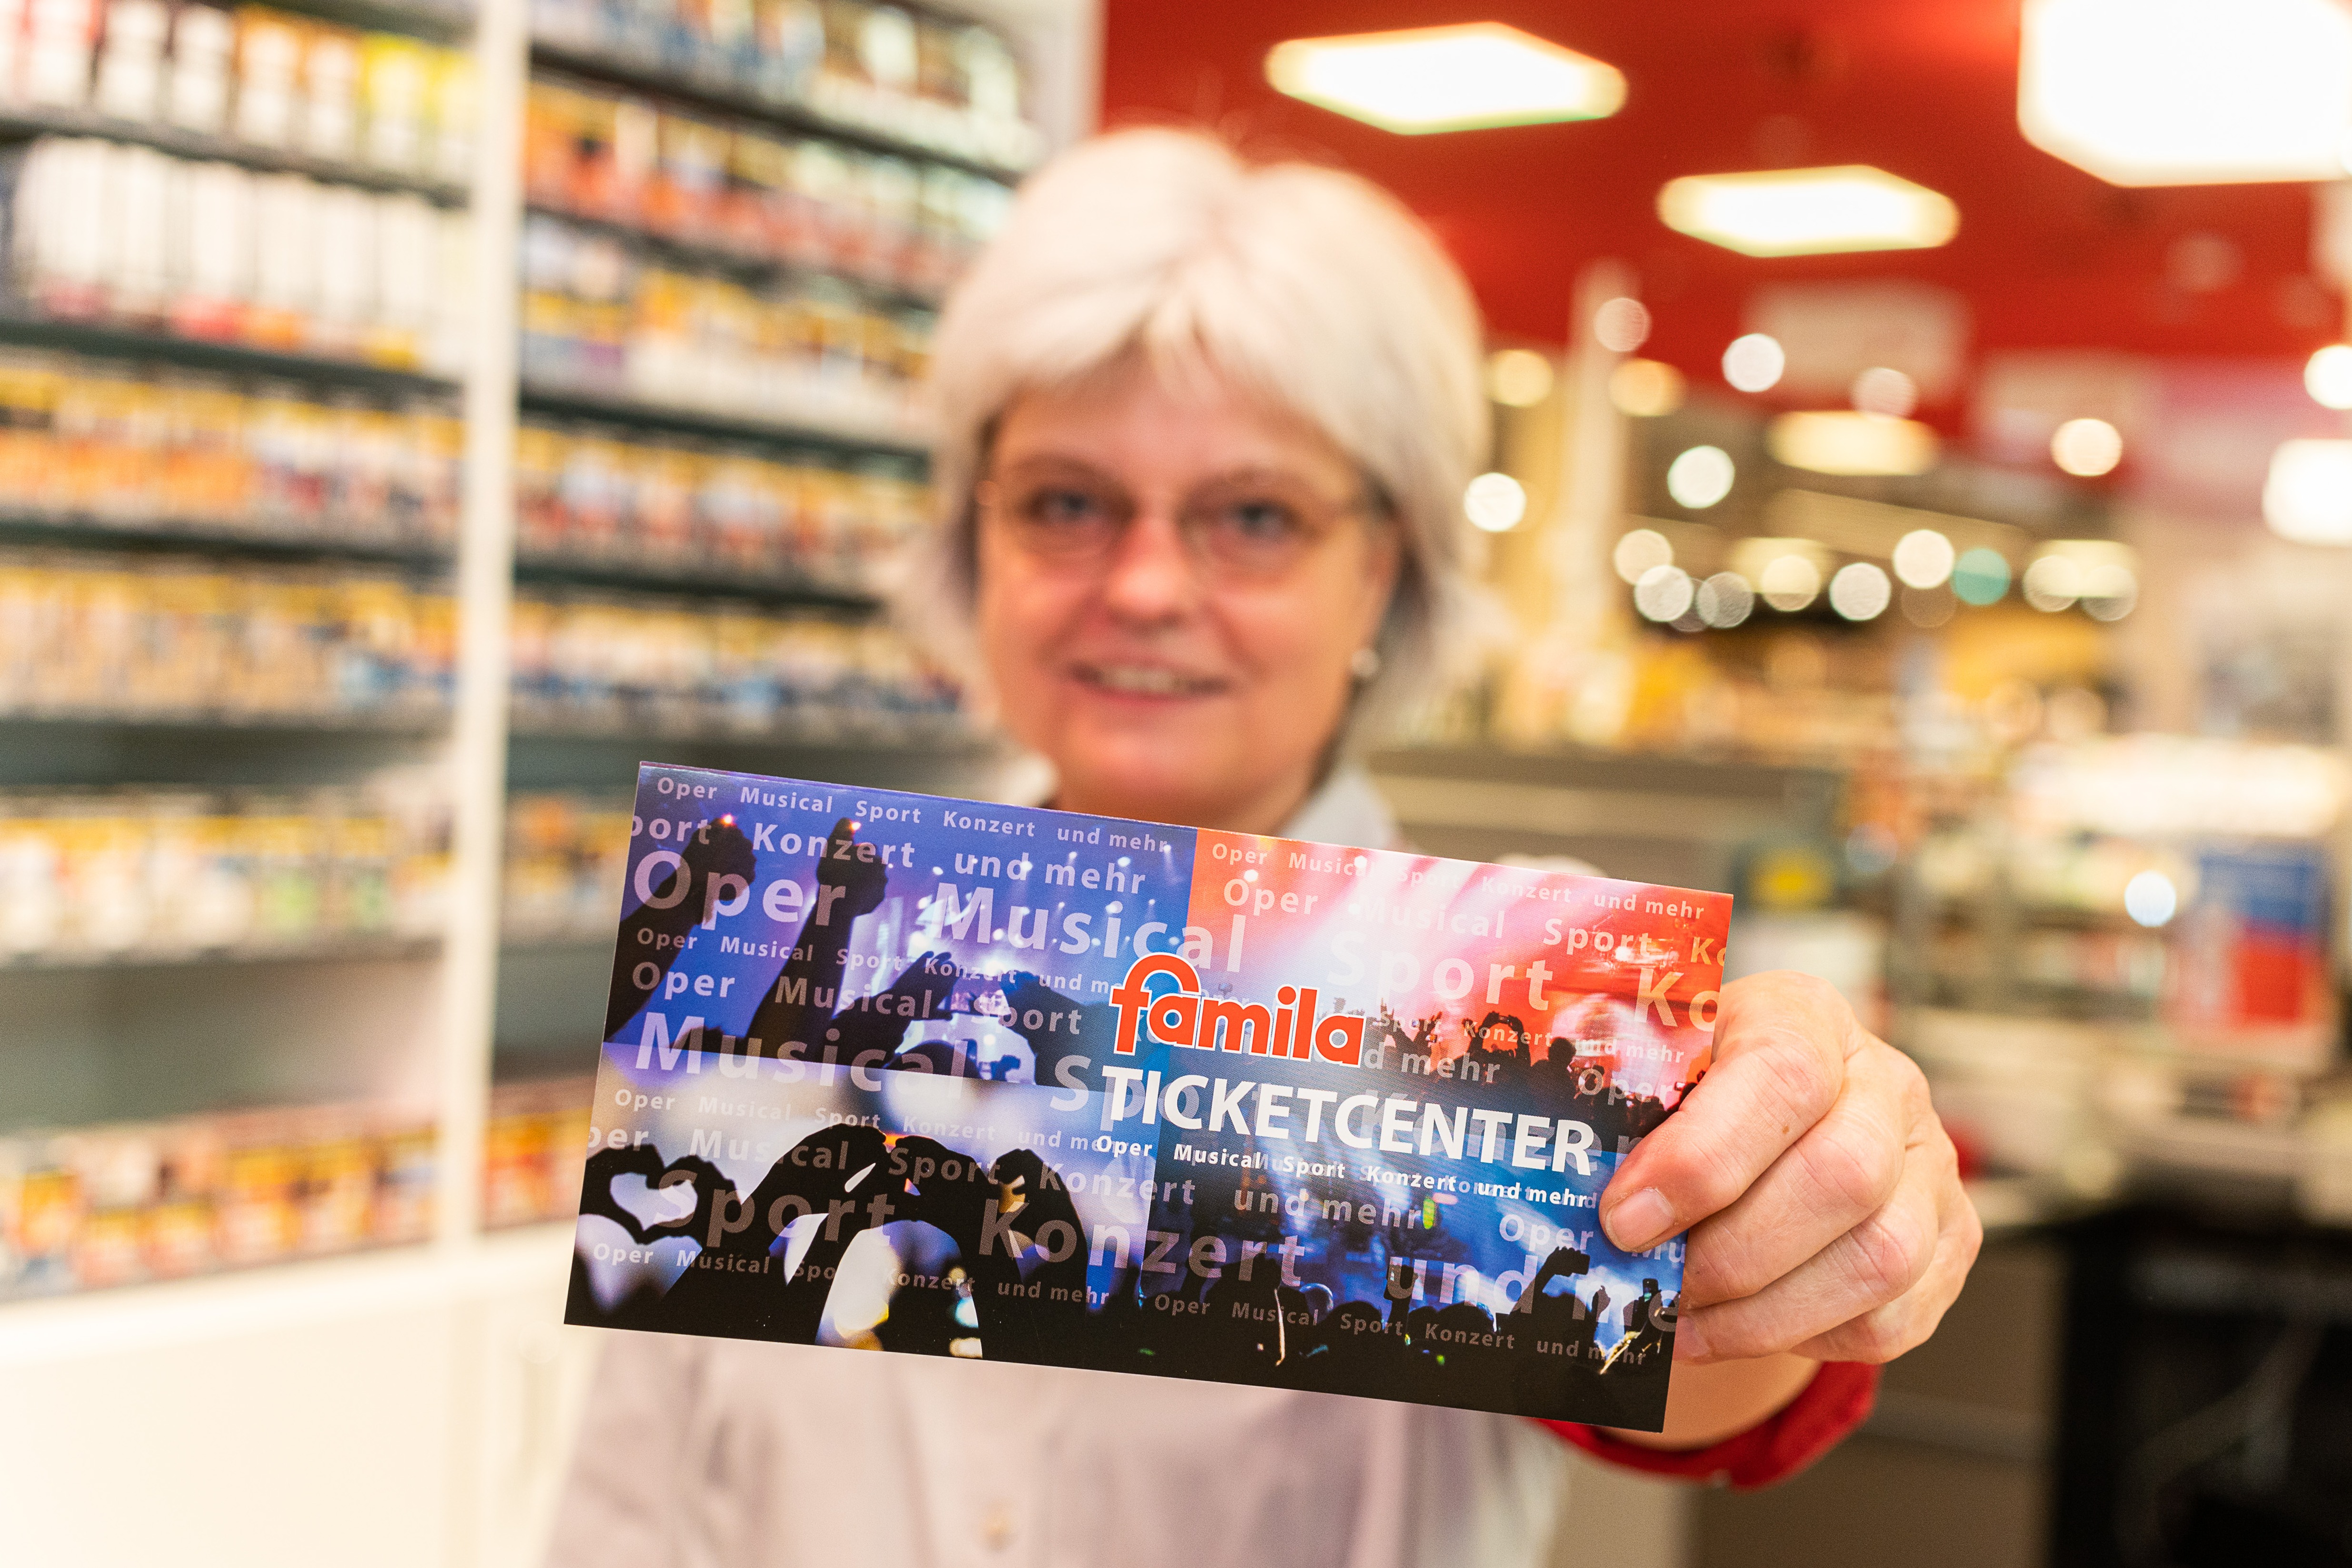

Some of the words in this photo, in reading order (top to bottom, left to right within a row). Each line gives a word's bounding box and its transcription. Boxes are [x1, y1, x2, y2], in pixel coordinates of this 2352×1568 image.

[658, 777, 717, 799] Oper
[741, 787, 833, 813] Musical
[855, 800, 921, 823] Sport
[944, 810, 1035, 837] Konzert
[1057, 827, 1100, 844] und
[1109, 832, 1168, 852] mehr
[1212, 843, 1268, 865] Oper
[1482, 876, 1572, 903] Konzert
[1594, 894, 1637, 911] und
[1646, 899, 1704, 919] mehr
[753, 823, 915, 868] Konzert
[955, 852, 1030, 880] und
[1045, 862, 1146, 894] mehr
[1223, 879, 1318, 916] Oper
[1361, 894, 1505, 939] Musical
[1543, 919, 1652, 958] Sport
[634, 851, 846, 930] Oper
[932, 882, 1246, 973] Musical
[1327, 930, 1553, 1010] Sport
[637, 928, 698, 949] Oper
[721, 936, 813, 961] Musical
[836, 949, 902, 971] Sport
[925, 959, 1017, 984] Konzert
[1040, 974, 1082, 991] und
[632, 962, 735, 1000] Oper
[775, 976, 933, 1019] Musical
[971, 996, 1081, 1035] Sport
[1109, 952, 1367, 1068] famila
[1378, 1010, 1441, 1032] Sport
[1464, 1021, 1553, 1047] Konzert
[1627, 1039, 1685, 1063] mehr
[635, 1012, 969, 1097] Musical
[1401, 1051, 1501, 1083] mehr
[1578, 1069, 1674, 1105] Oper
[615, 1089, 676, 1111] Oper
[698, 1097, 791, 1121] Musical
[815, 1108, 881, 1129] Sport
[903, 1116, 996, 1142] Konzert
[1018, 1130, 1061, 1148] und
[1097, 1135, 1152, 1158] Oper
[1173, 1144, 1261, 1170] Musical
[1283, 1156, 1345, 1179] Sport
[1367, 1166, 1456, 1192] Konzert
[1478, 1181, 1521, 1199] und
[1529, 1186, 1587, 1208] mehr
[1102, 1065, 1594, 1176] TICKETCENTER
[653, 1170, 896, 1248] Sport
[979, 1199, 1304, 1287] Konzert
[1387, 1256, 1538, 1314] und
[690, 1129, 848, 1170] Musical
[888, 1147, 999, 1185] Sport
[1040, 1162, 1195, 1205] Konzert
[1234, 1188, 1307, 1217] und
[1322, 1198, 1422, 1229] mehr
[1499, 1214, 1593, 1251] Oper
[593, 1243, 653, 1266] Oper
[677, 1250, 770, 1274] Musical
[886, 1269, 976, 1293] Konzert
[998, 1282, 1041, 1298] und
[1051, 1286, 1110, 1305] mehr
[1155, 1294, 1211, 1315] Oper
[1232, 1302, 1319, 1326] Musical
[1340, 1314, 1403, 1336] Sport
[1425, 1324, 1515, 1349] Konzert
[1537, 1339, 1579, 1357] und
[1588, 1344, 1647, 1365] mhr
